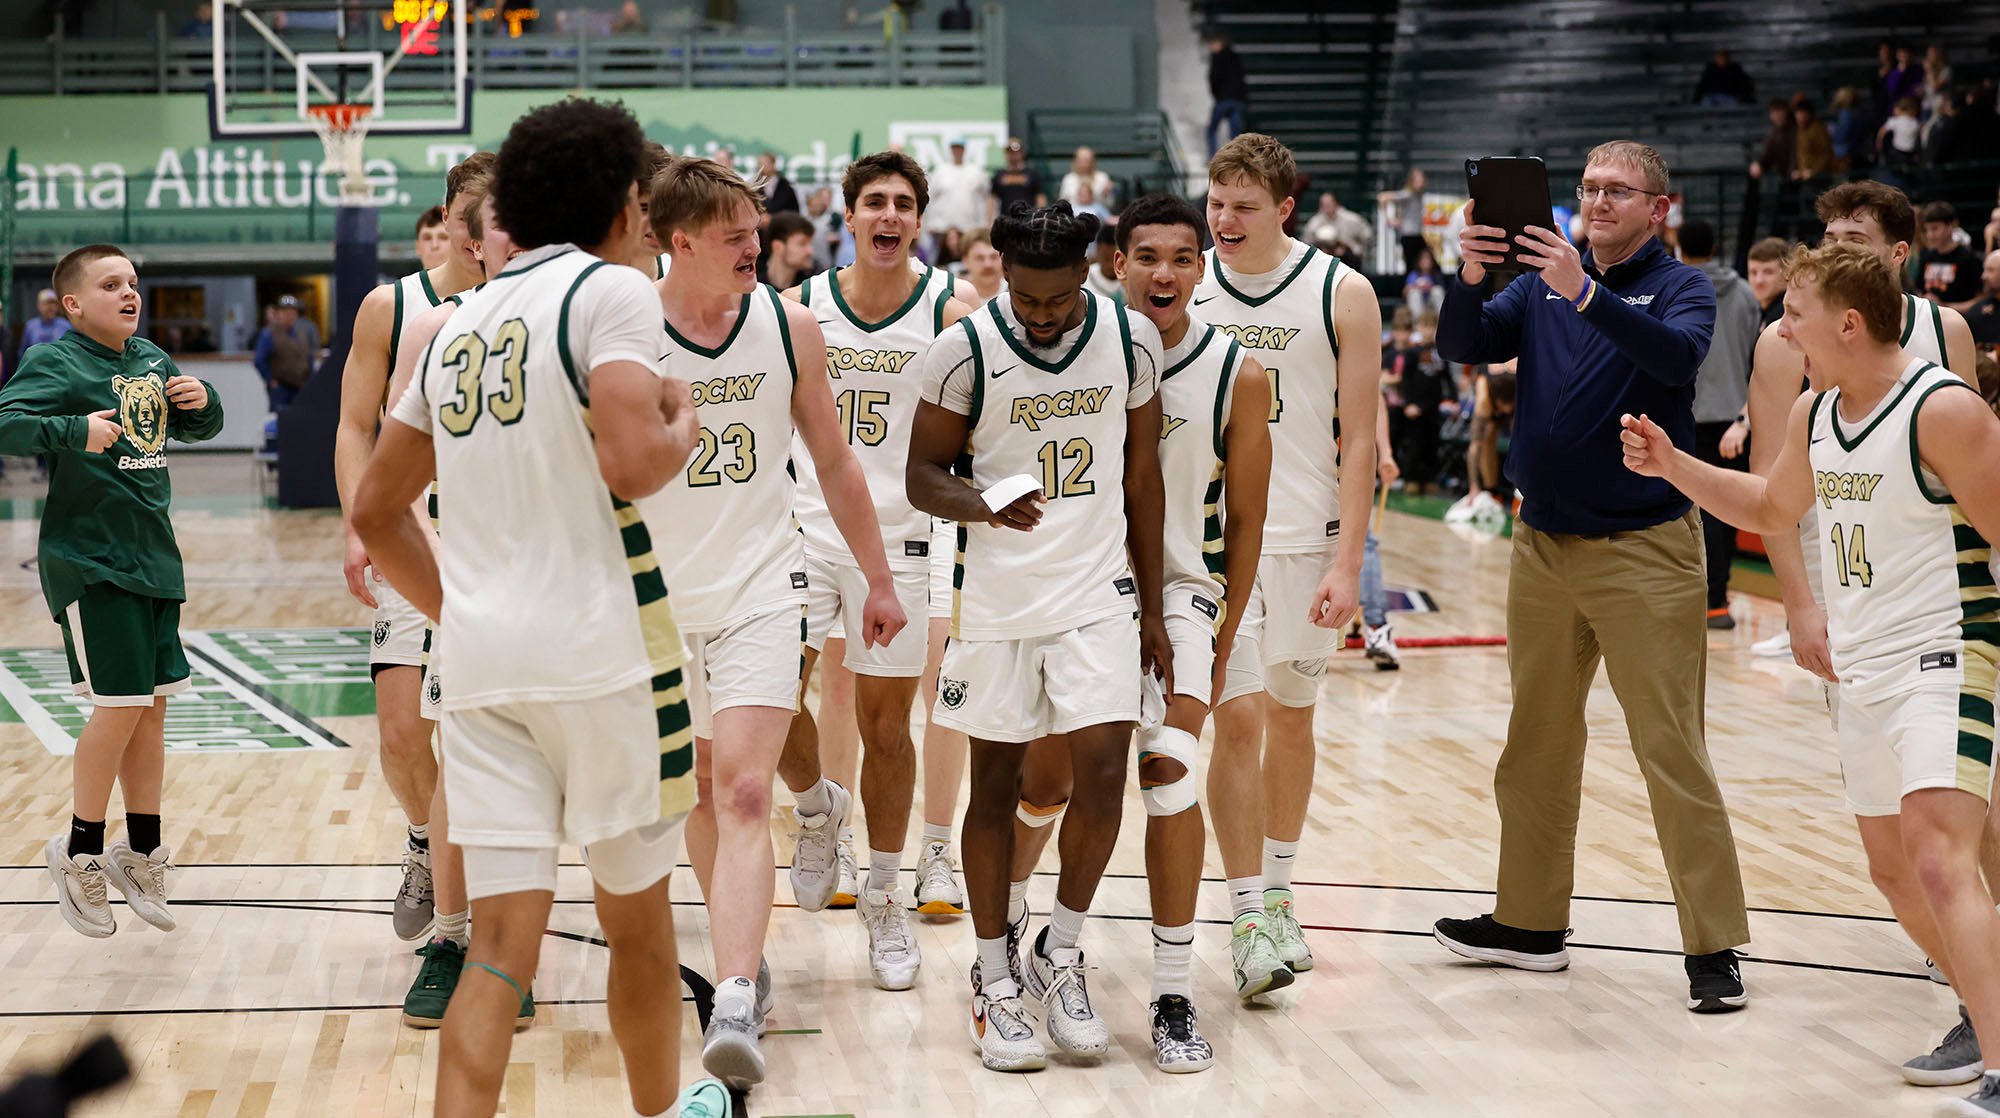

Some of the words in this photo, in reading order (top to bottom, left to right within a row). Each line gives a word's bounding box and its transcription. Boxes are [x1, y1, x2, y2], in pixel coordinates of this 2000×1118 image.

[1206, 323, 1301, 350] OCKY
[439, 317, 529, 437] 33
[826, 346, 917, 379] ROCKY
[690, 372, 767, 408] OCKY
[1010, 385, 1113, 432] ROCKY
[836, 389, 890, 447] 15
[687, 423, 757, 488] 23
[1038, 437, 1095, 500] 12
[1817, 470, 1884, 509] ROCKY
[1831, 522, 1874, 588] 14
[1942, 655, 1954, 664] XL
